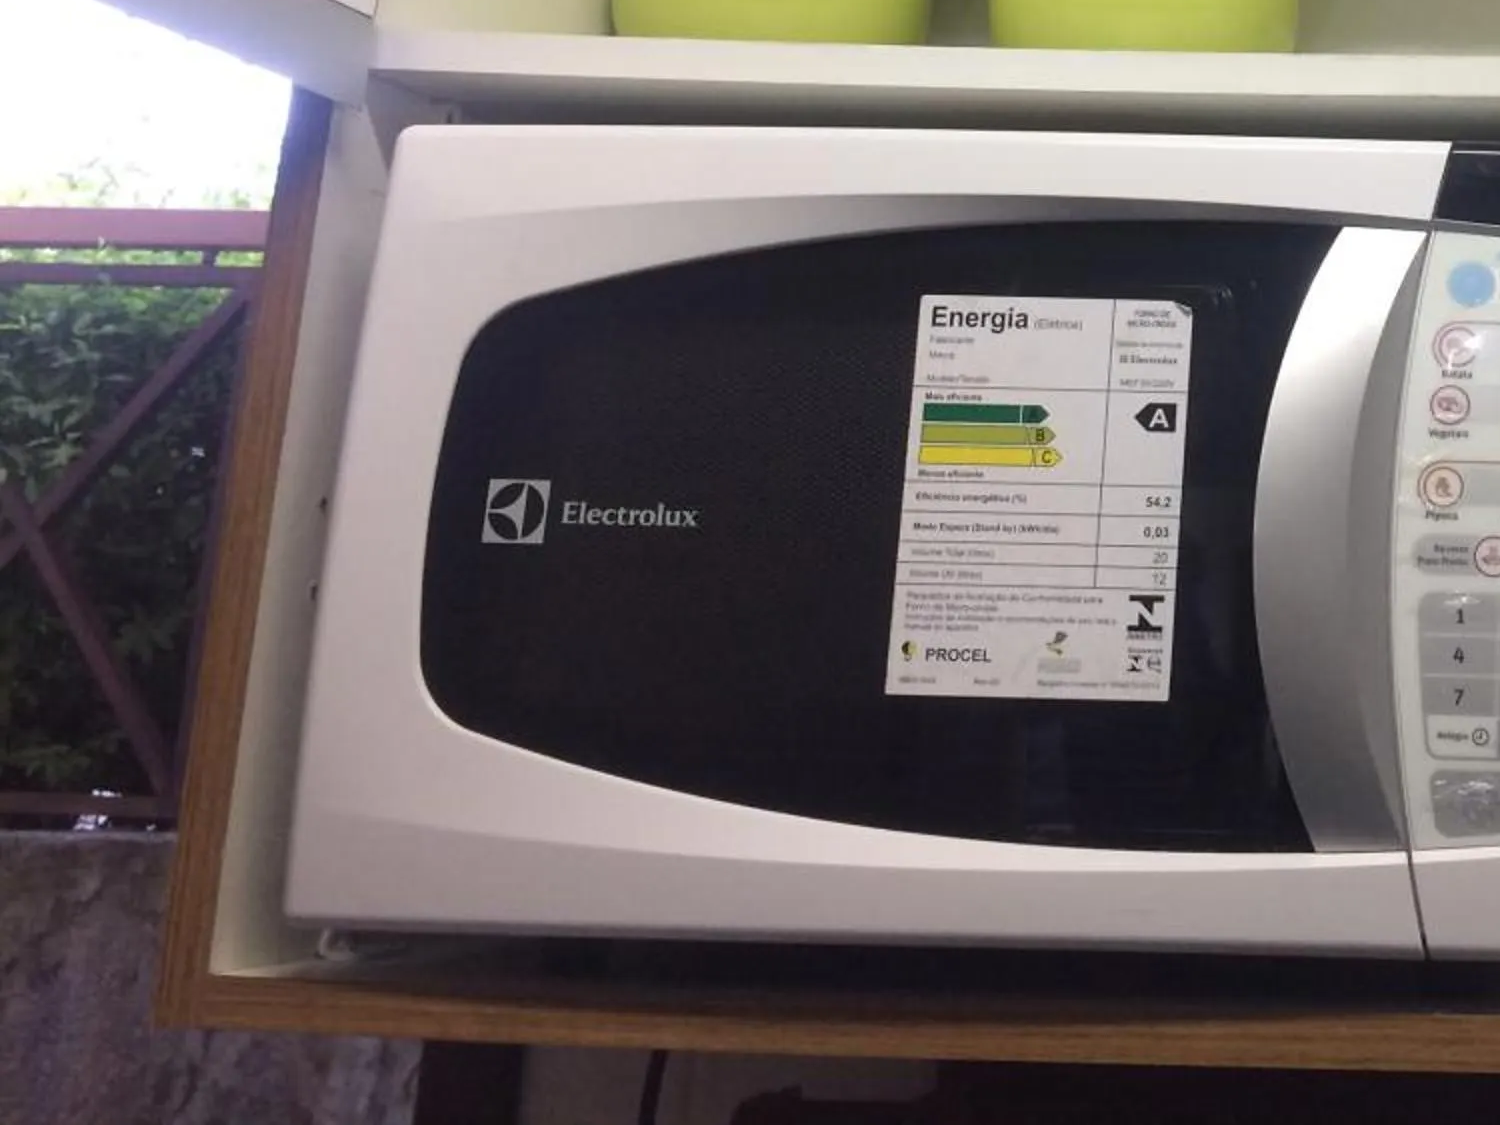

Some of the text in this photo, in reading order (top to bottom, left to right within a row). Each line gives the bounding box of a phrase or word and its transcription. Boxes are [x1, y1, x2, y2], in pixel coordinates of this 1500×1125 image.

[931, 306, 1029, 333] Energia
[1150, 408, 1169, 428] A
[1035, 429, 1045, 442] B
[1041, 451, 1052, 464] C
[560, 501, 700, 527] Electrolux
[1455, 608, 1465, 625] 1
[925, 648, 992, 663] PROCEL
[1453, 647, 1465, 664] 4
[1454, 689, 1464, 705] 7
